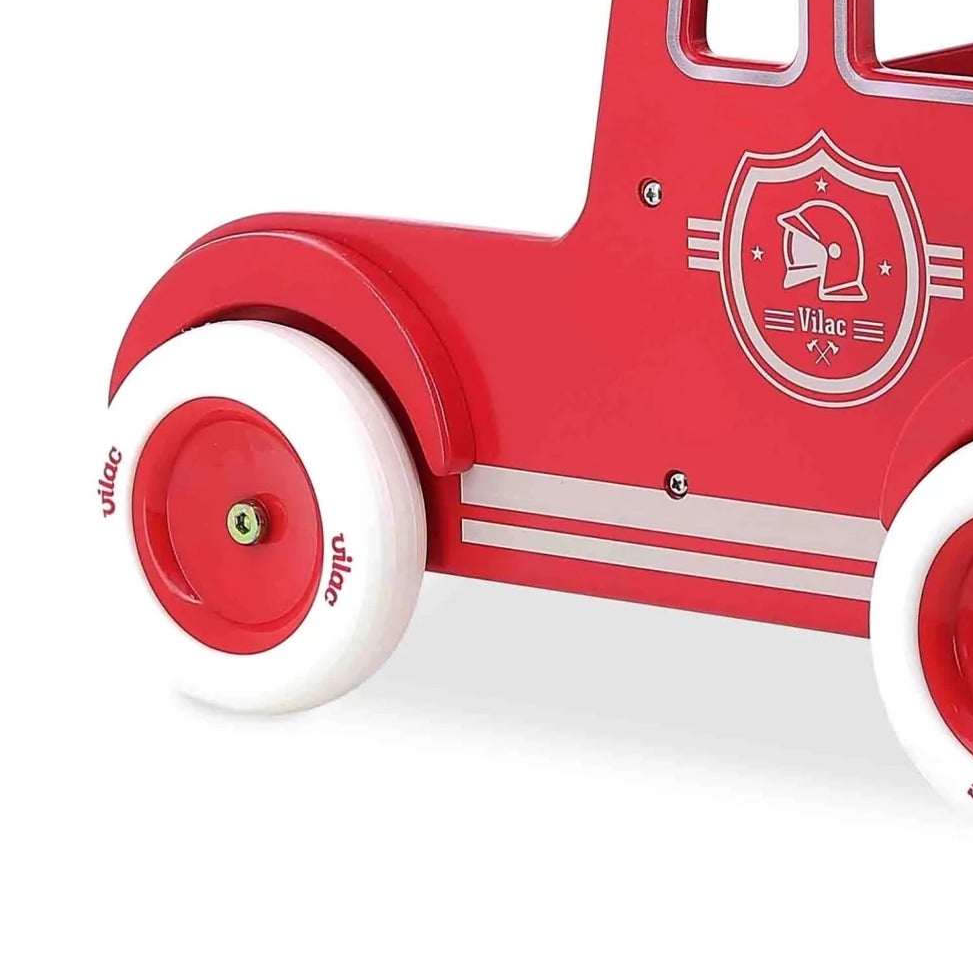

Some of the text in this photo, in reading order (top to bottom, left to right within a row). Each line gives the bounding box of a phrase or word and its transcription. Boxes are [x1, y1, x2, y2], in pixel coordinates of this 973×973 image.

[798, 306, 847, 337] Vilac
[97, 445, 123, 518] vilac
[324, 533, 354, 607] vilac
